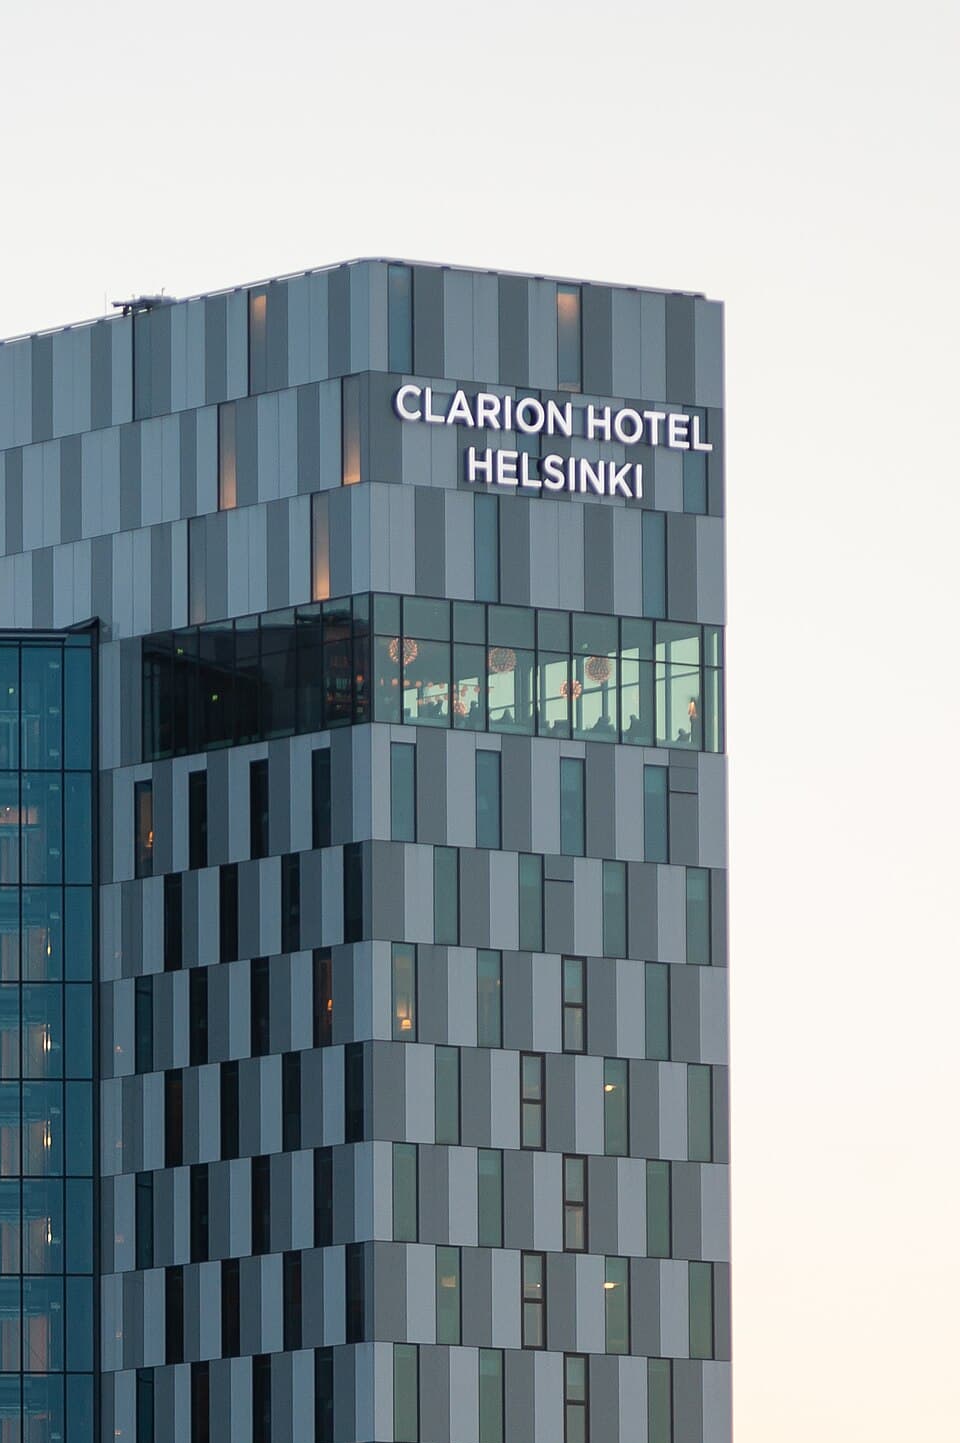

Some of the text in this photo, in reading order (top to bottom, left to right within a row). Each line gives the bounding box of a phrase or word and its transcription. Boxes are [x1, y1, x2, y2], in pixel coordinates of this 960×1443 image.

[395, 384, 713, 451] CLARION HOTEL
[467, 446, 643, 499] HELSINKI
